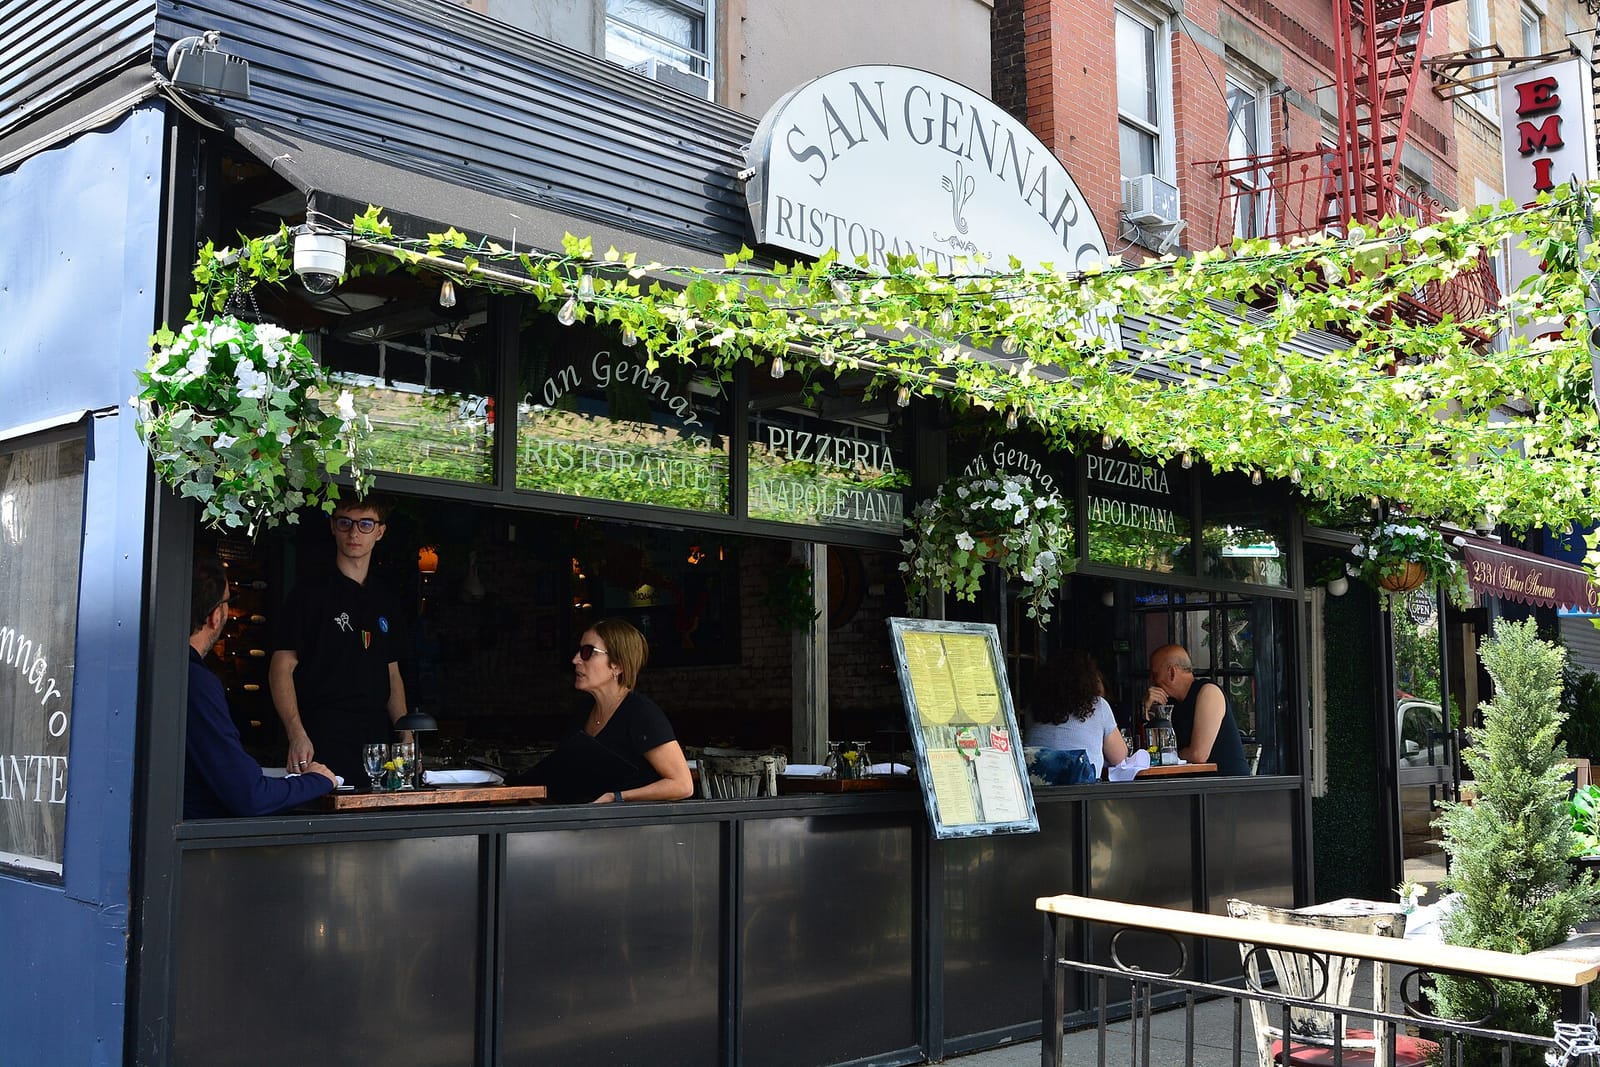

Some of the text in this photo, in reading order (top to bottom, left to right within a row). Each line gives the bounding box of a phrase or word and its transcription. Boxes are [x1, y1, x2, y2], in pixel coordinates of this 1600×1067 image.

[786, 81, 890, 186] SAN
[1514, 77, 1564, 209] EMI
[592, 351, 712, 452] Gennaro
[524, 436, 715, 491] RISTORANTE
[768, 426, 896, 476] PIZZERIA
[1086, 453, 1170, 495] PIZZERIA
[758, 478, 904, 524] NAPOLETANA
[1260, 560, 1282, 578] 2329
[1472, 560, 1497, 586] 2331
[1524, 568, 1556, 599] Avenue
[1411, 604, 1431, 616] OPEN
